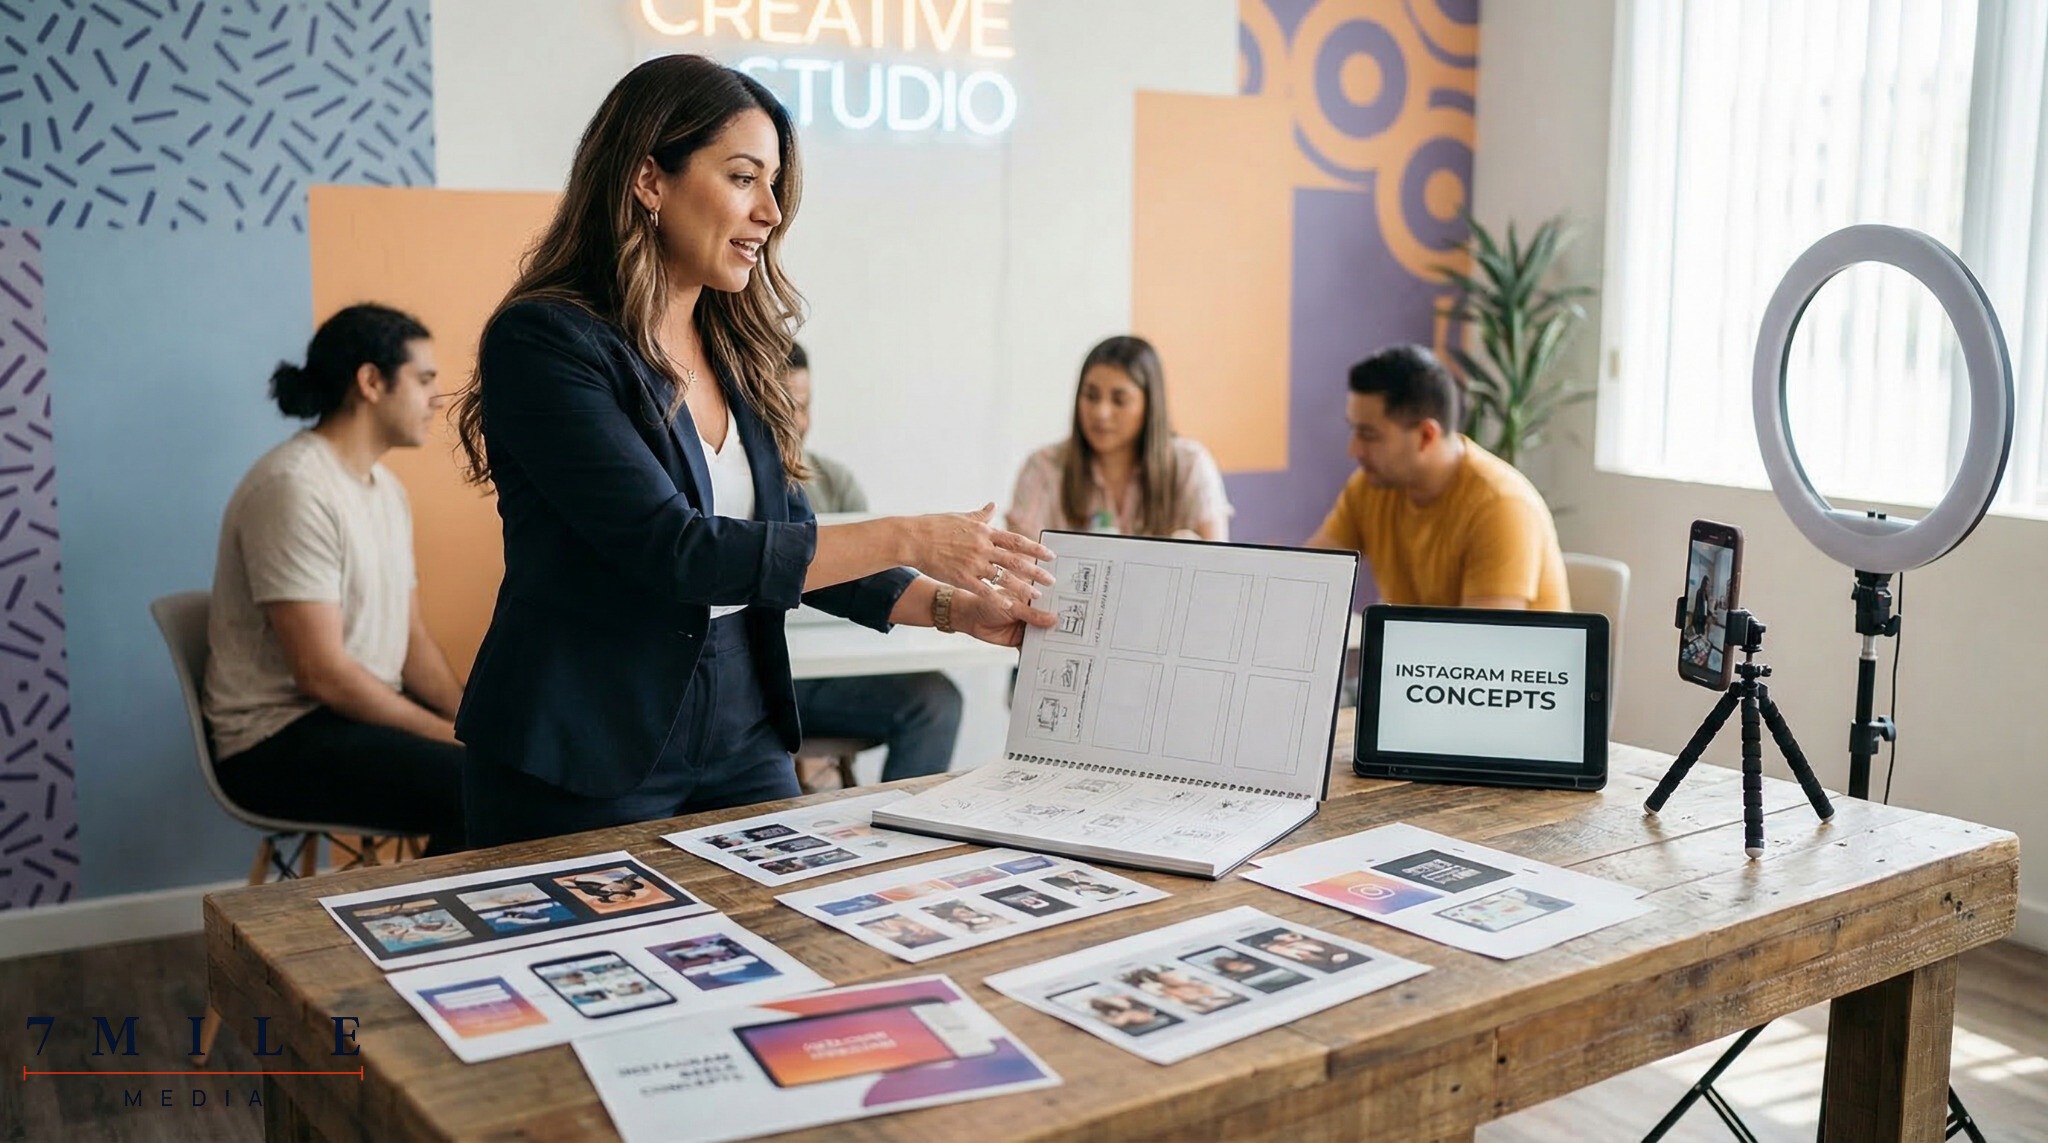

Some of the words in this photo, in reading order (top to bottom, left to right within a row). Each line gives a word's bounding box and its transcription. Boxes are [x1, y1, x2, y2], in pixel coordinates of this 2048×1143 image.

[1396, 664, 1504, 682] INSTAGRAM
[1511, 670, 1569, 685] REELS
[1406, 684, 1556, 710] CONCEPTS
